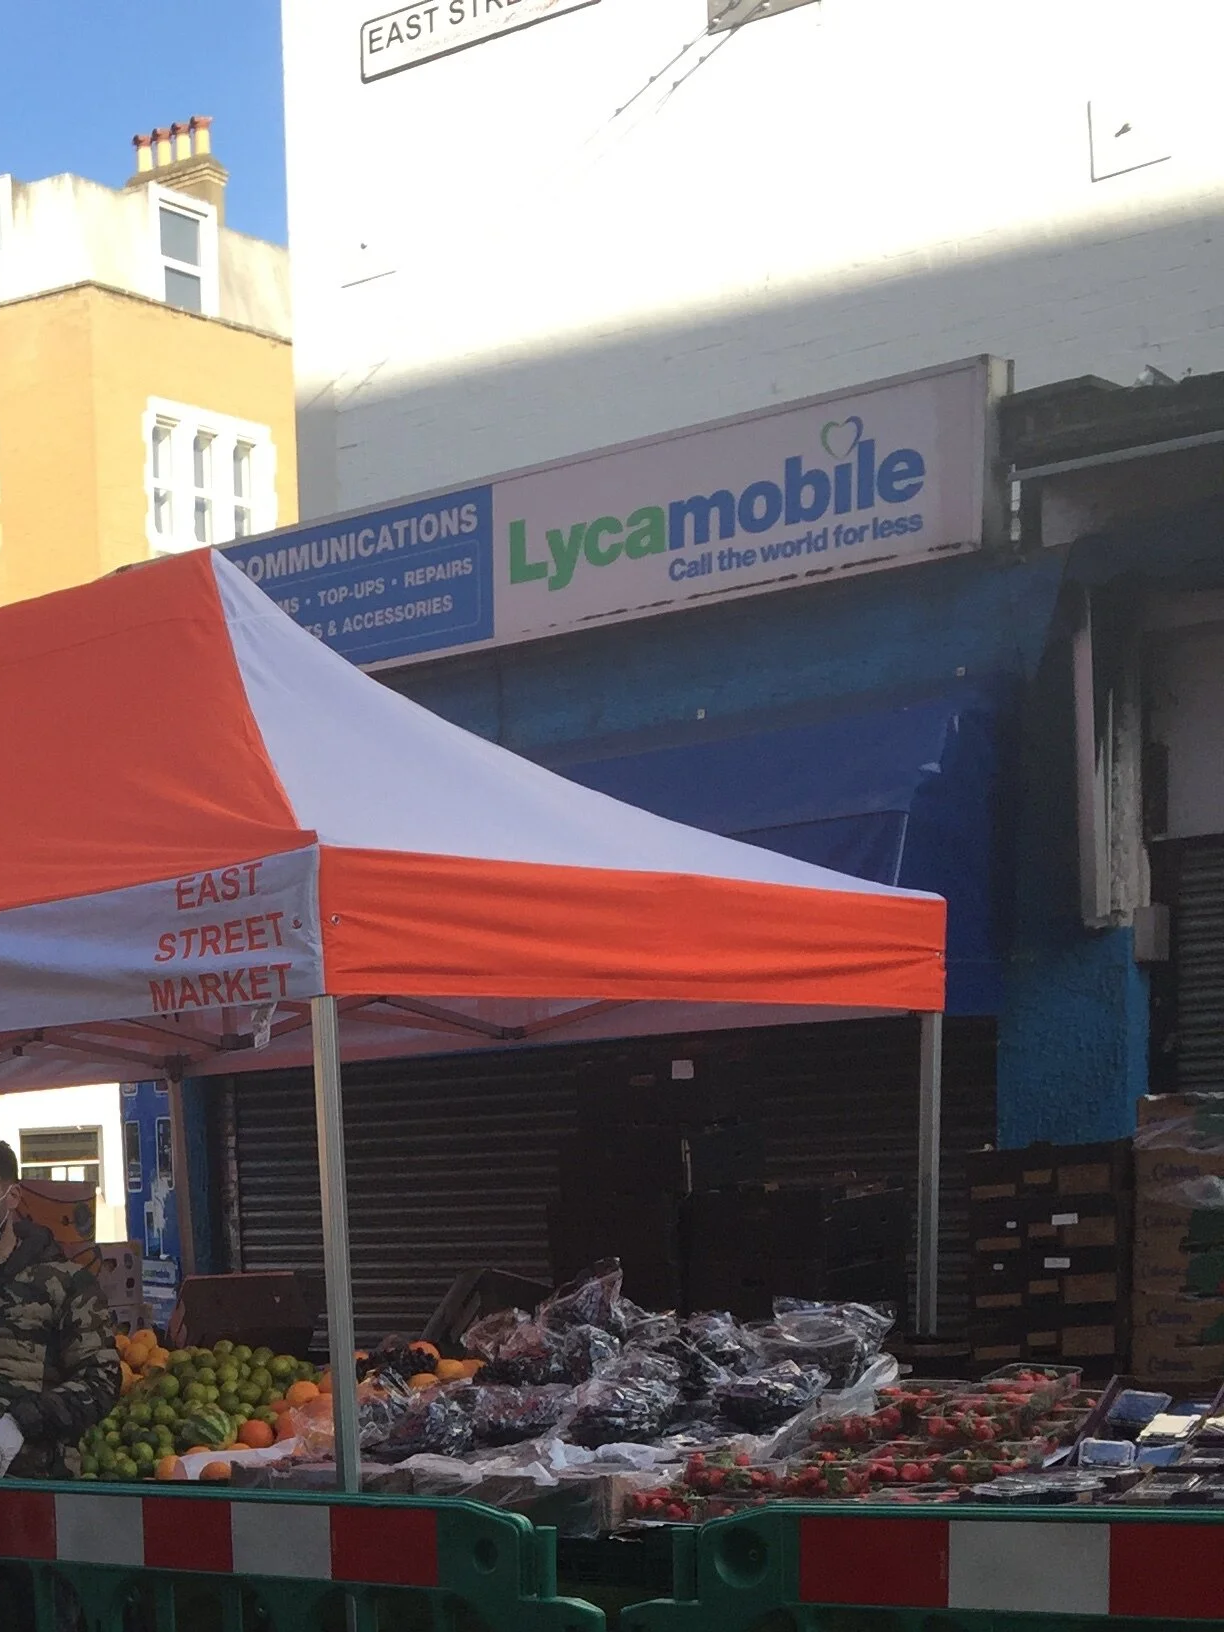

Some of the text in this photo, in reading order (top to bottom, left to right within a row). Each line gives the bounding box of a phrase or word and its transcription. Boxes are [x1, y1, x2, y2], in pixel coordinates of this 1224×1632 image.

[369, 7, 439, 54] EAST
[509, 438, 926, 591] Lycamobile
[235, 503, 478, 582] OMMUNICATIONS
[669, 513, 923, 582] Call the world for less
[318, 578, 385, 607] TOP-UPS
[404, 558, 472, 587] REPAIRS
[328, 620, 338, 637] &
[342, 595, 453, 633] ACCESSORIES
[176, 862, 263, 910] EAST
[154, 912, 284, 962] STREET
[148, 963, 292, 1012] MARKET
